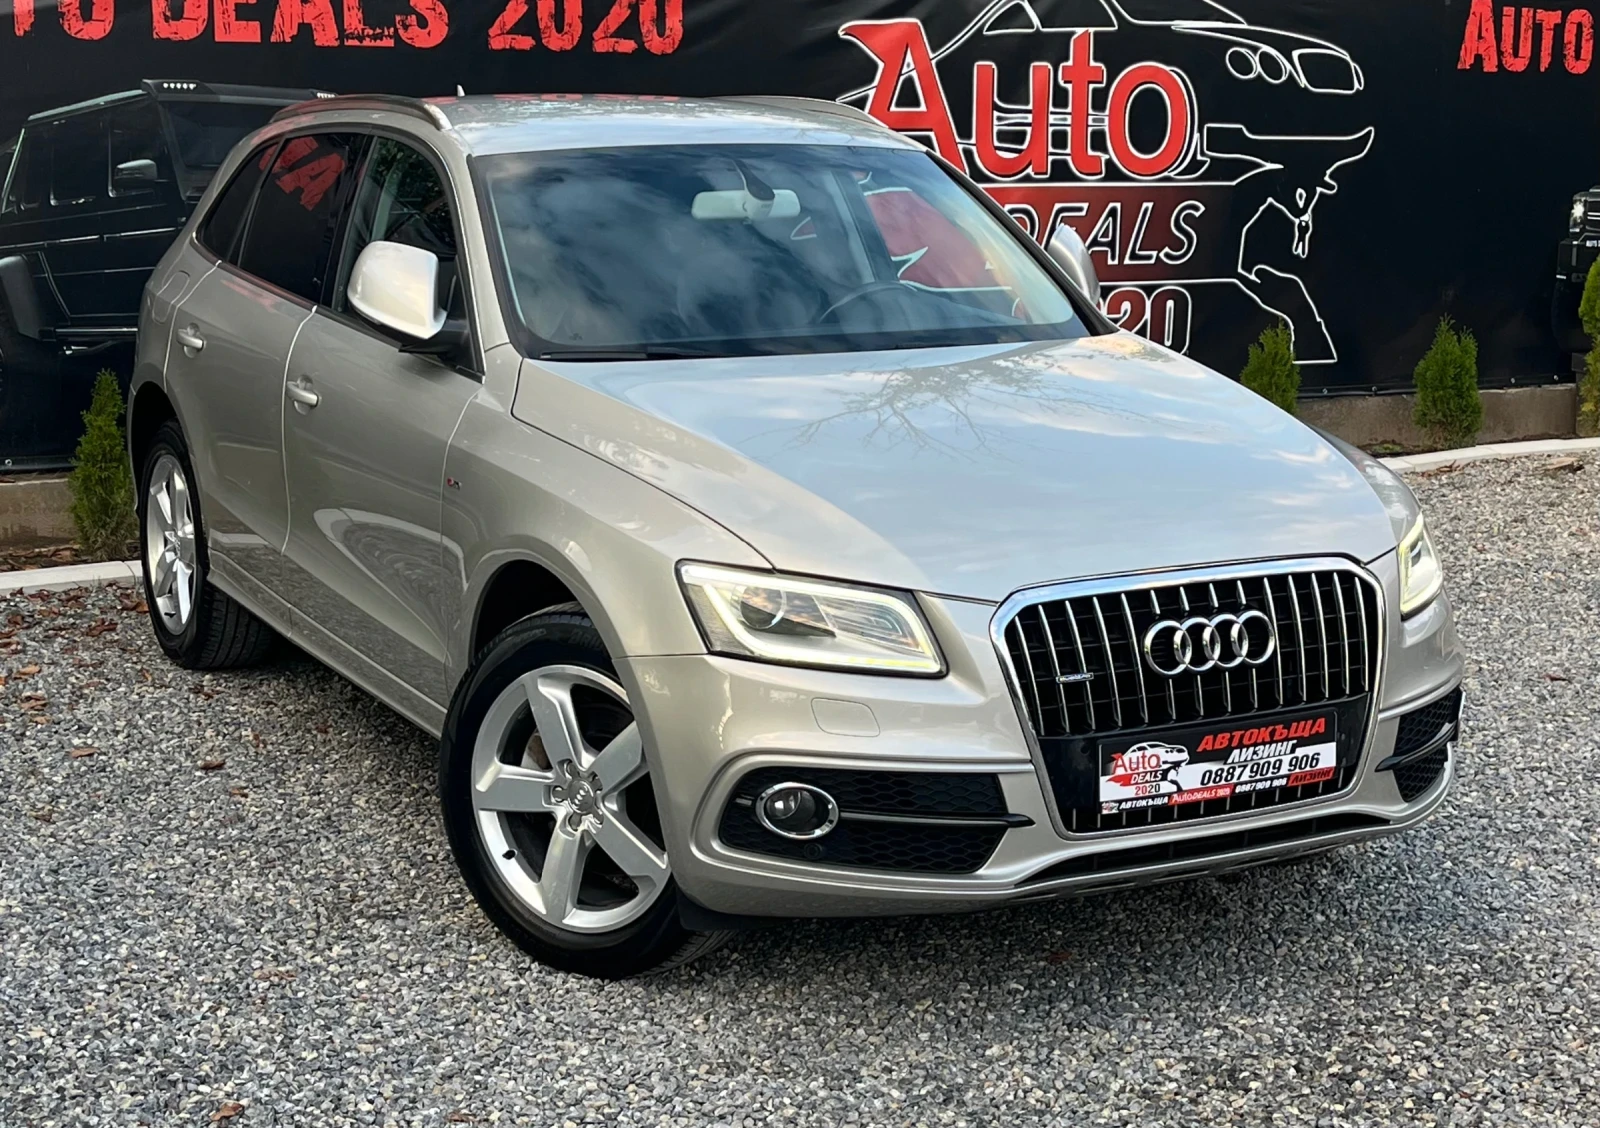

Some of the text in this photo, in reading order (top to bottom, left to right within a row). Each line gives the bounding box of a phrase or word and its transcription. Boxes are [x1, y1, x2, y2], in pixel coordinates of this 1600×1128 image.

[487, 0, 684, 55] 2020
[1457, 0, 1594, 75] AUTO
[838, 20, 1191, 178] Auto
[1197, 717, 1326, 752] АВТОКЪЩА
[1111, 751, 1161, 775] Auto
[1200, 752, 1321, 786] 0887 909 906
[1226, 740, 1297, 764] ЛИЗИНГ
[1130, 771, 1163, 784] DEALS
[1134, 783, 1161, 796] 2020
